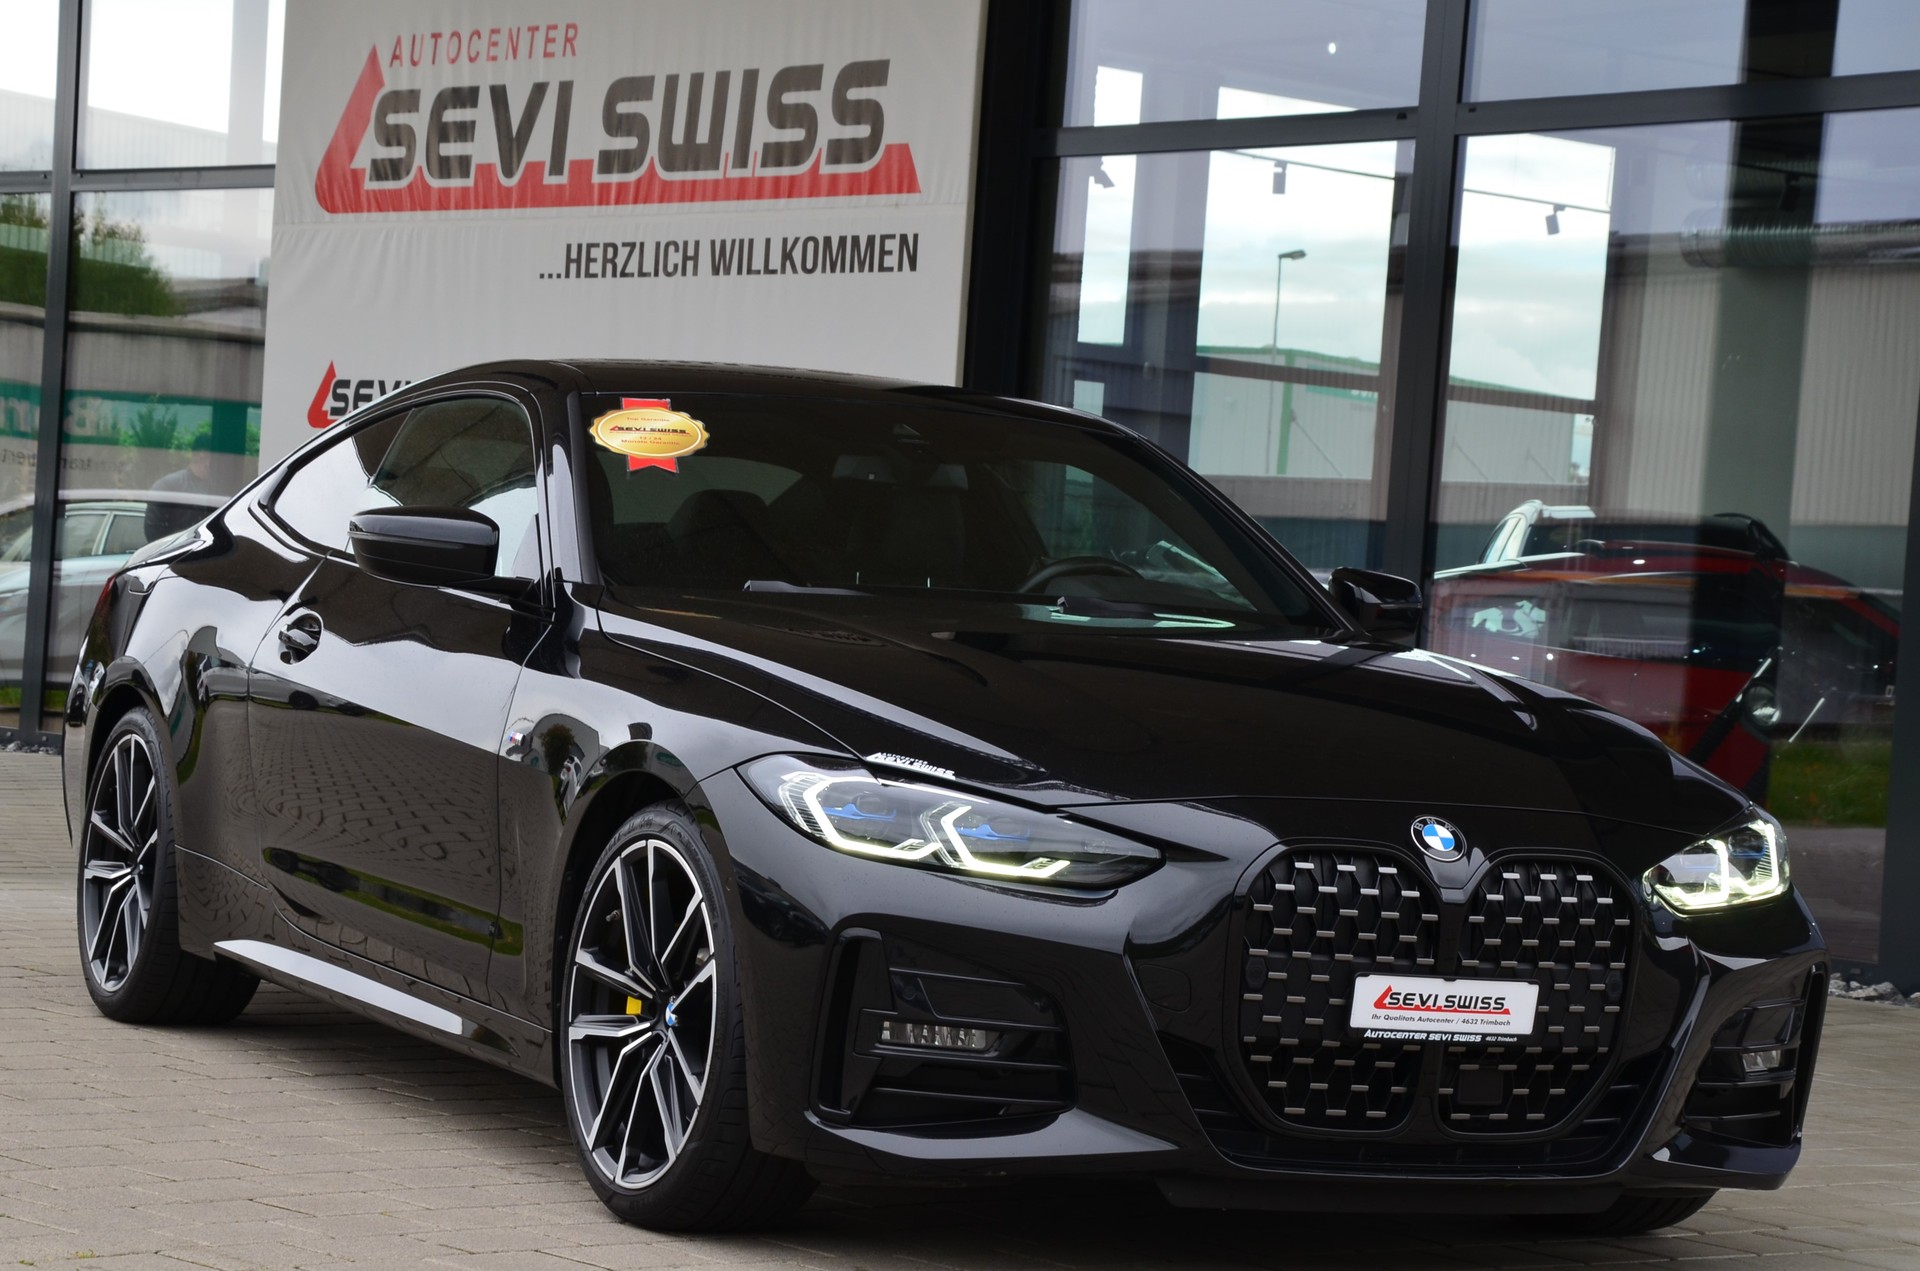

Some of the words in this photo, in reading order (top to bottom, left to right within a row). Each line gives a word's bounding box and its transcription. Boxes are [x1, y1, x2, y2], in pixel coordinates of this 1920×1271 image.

[389, 22, 579, 68] AUTOCENTER
[368, 80, 574, 182] SEVI
[597, 59, 890, 175] SWISS
[711, 233, 918, 276] WILLKOMMEN
[1413, 817, 1455, 832] BMW
[1388, 991, 1439, 1008] SEVI
[1444, 994, 1506, 1011] SWISS
[1371, 1013, 1382, 1021] Ihr
[1417, 1015, 1455, 1024] Autocenter
[1461, 1018, 1479, 1026] 4632
[1480, 1018, 1511, 1027] Trimbach
[1428, 1033, 1451, 1041] SEVI
[1452, 1034, 1482, 1043] SWISS
